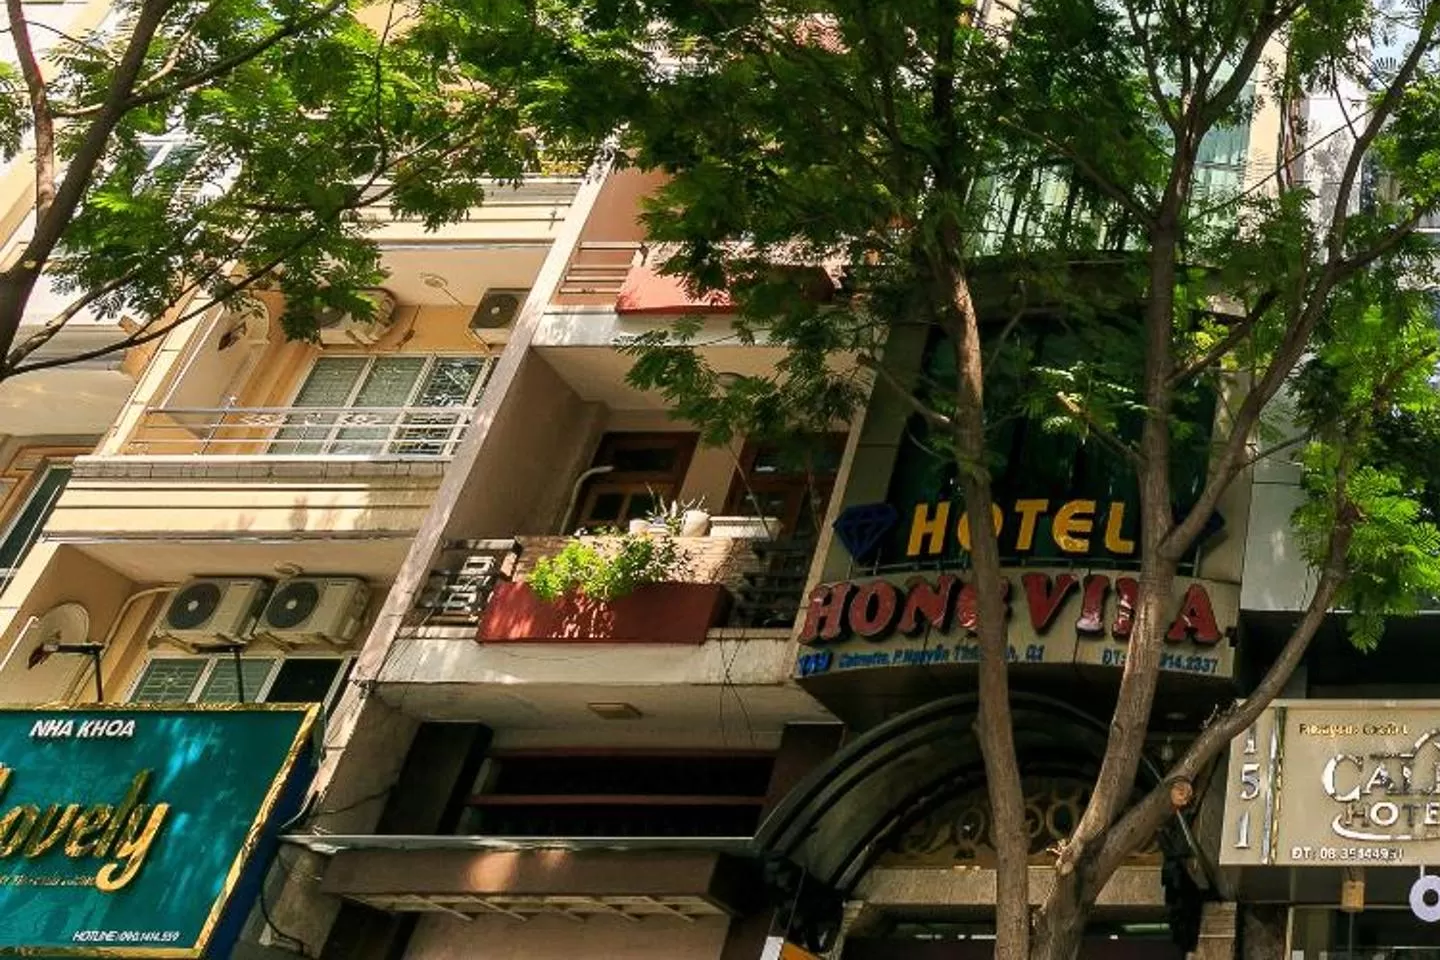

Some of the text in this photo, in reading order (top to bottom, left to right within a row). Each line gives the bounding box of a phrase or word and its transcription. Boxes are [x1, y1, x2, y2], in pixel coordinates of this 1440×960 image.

[30, 720, 135, 738] NHA KHOA
[0, 762, 171, 891] ovely
